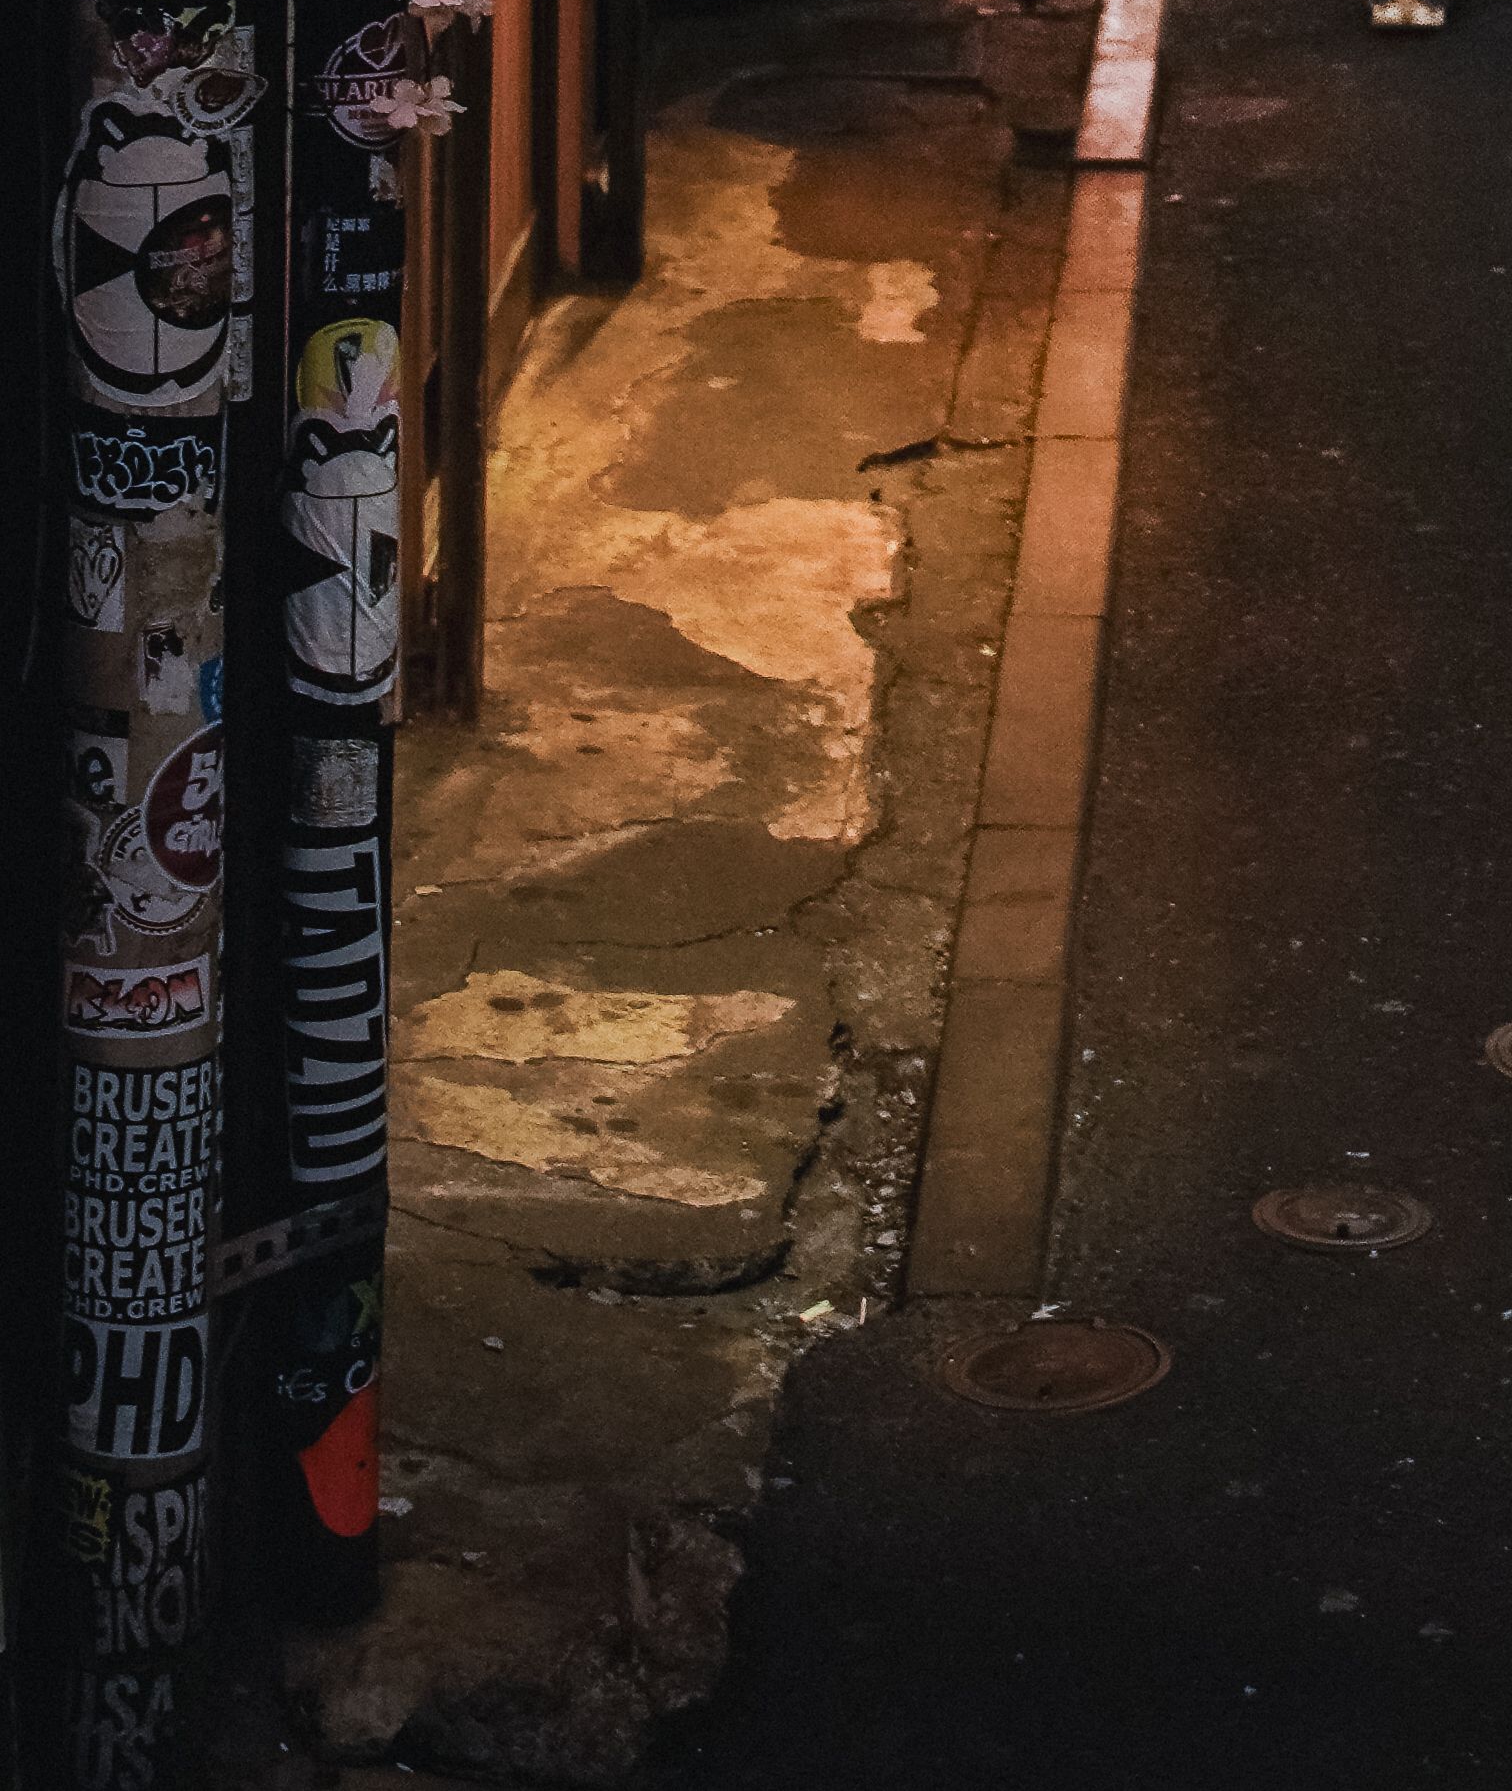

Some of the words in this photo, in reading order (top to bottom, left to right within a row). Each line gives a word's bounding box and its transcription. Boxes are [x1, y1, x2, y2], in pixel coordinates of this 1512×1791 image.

[71, 1112, 213, 1173] CREATE
[64, 1239, 206, 1299] CREATE
[65, 1322, 203, 1455] PHD
